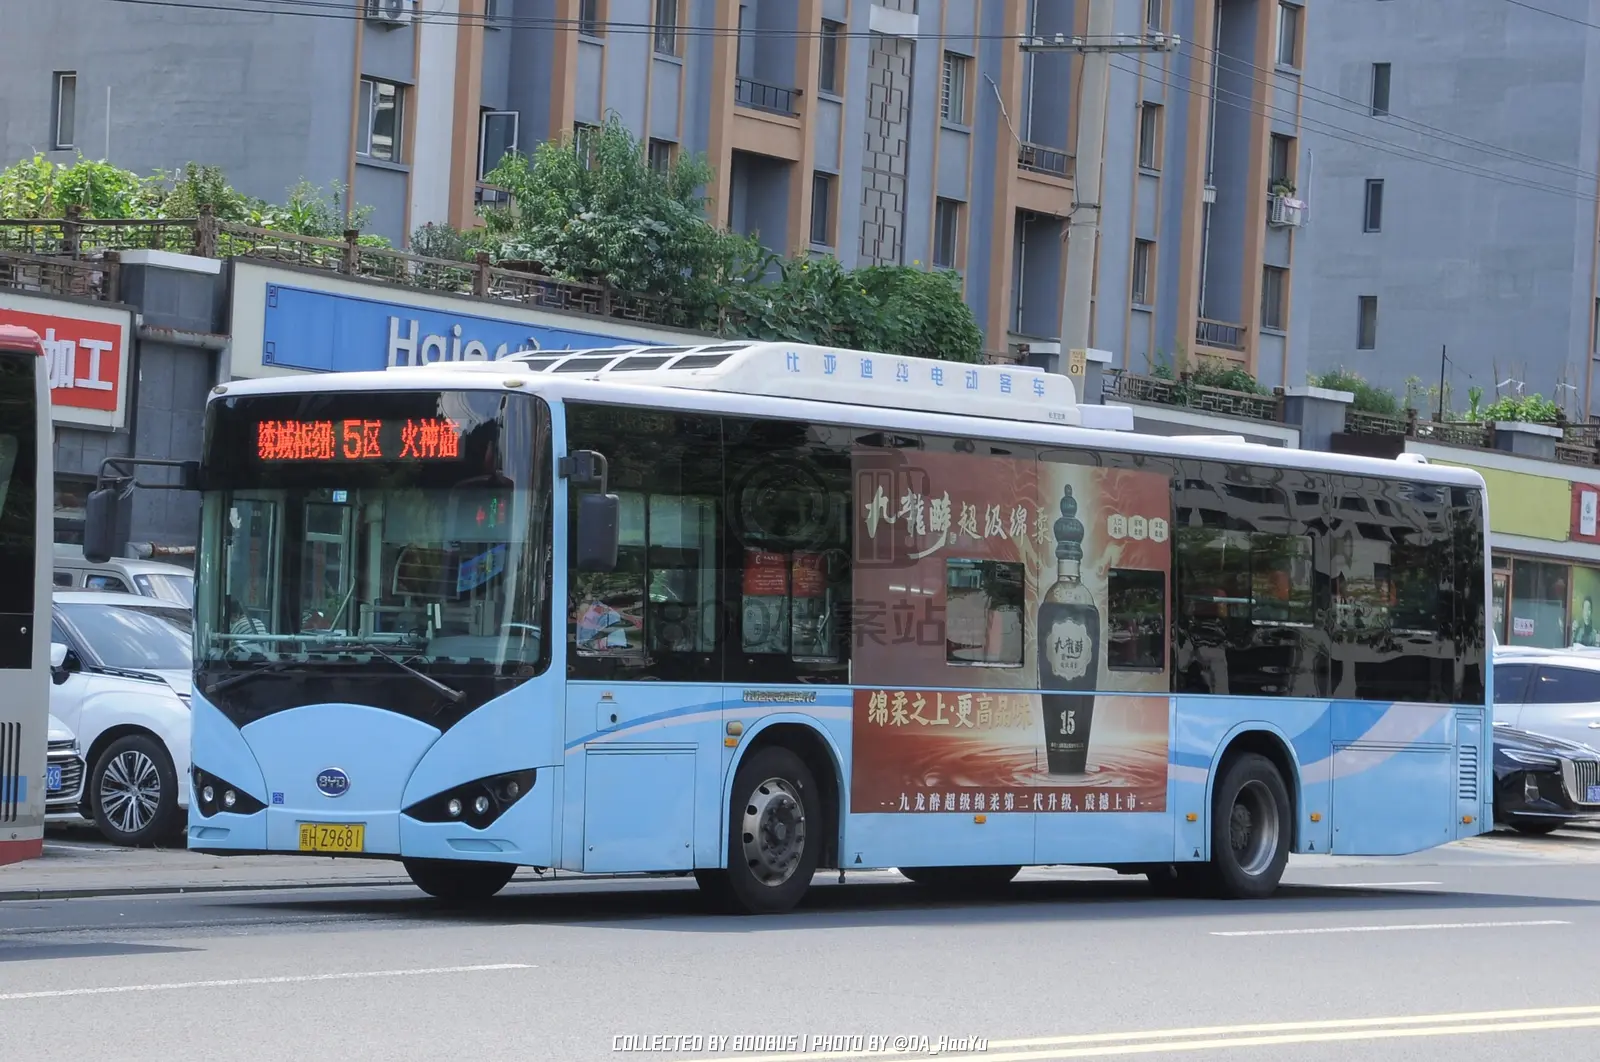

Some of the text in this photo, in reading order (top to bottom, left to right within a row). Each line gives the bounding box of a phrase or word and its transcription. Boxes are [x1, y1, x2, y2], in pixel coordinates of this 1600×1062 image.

[43, 328, 113, 391] 加工
[1060, 709, 1076, 735] 15
[319, 775, 346, 788] BYD
